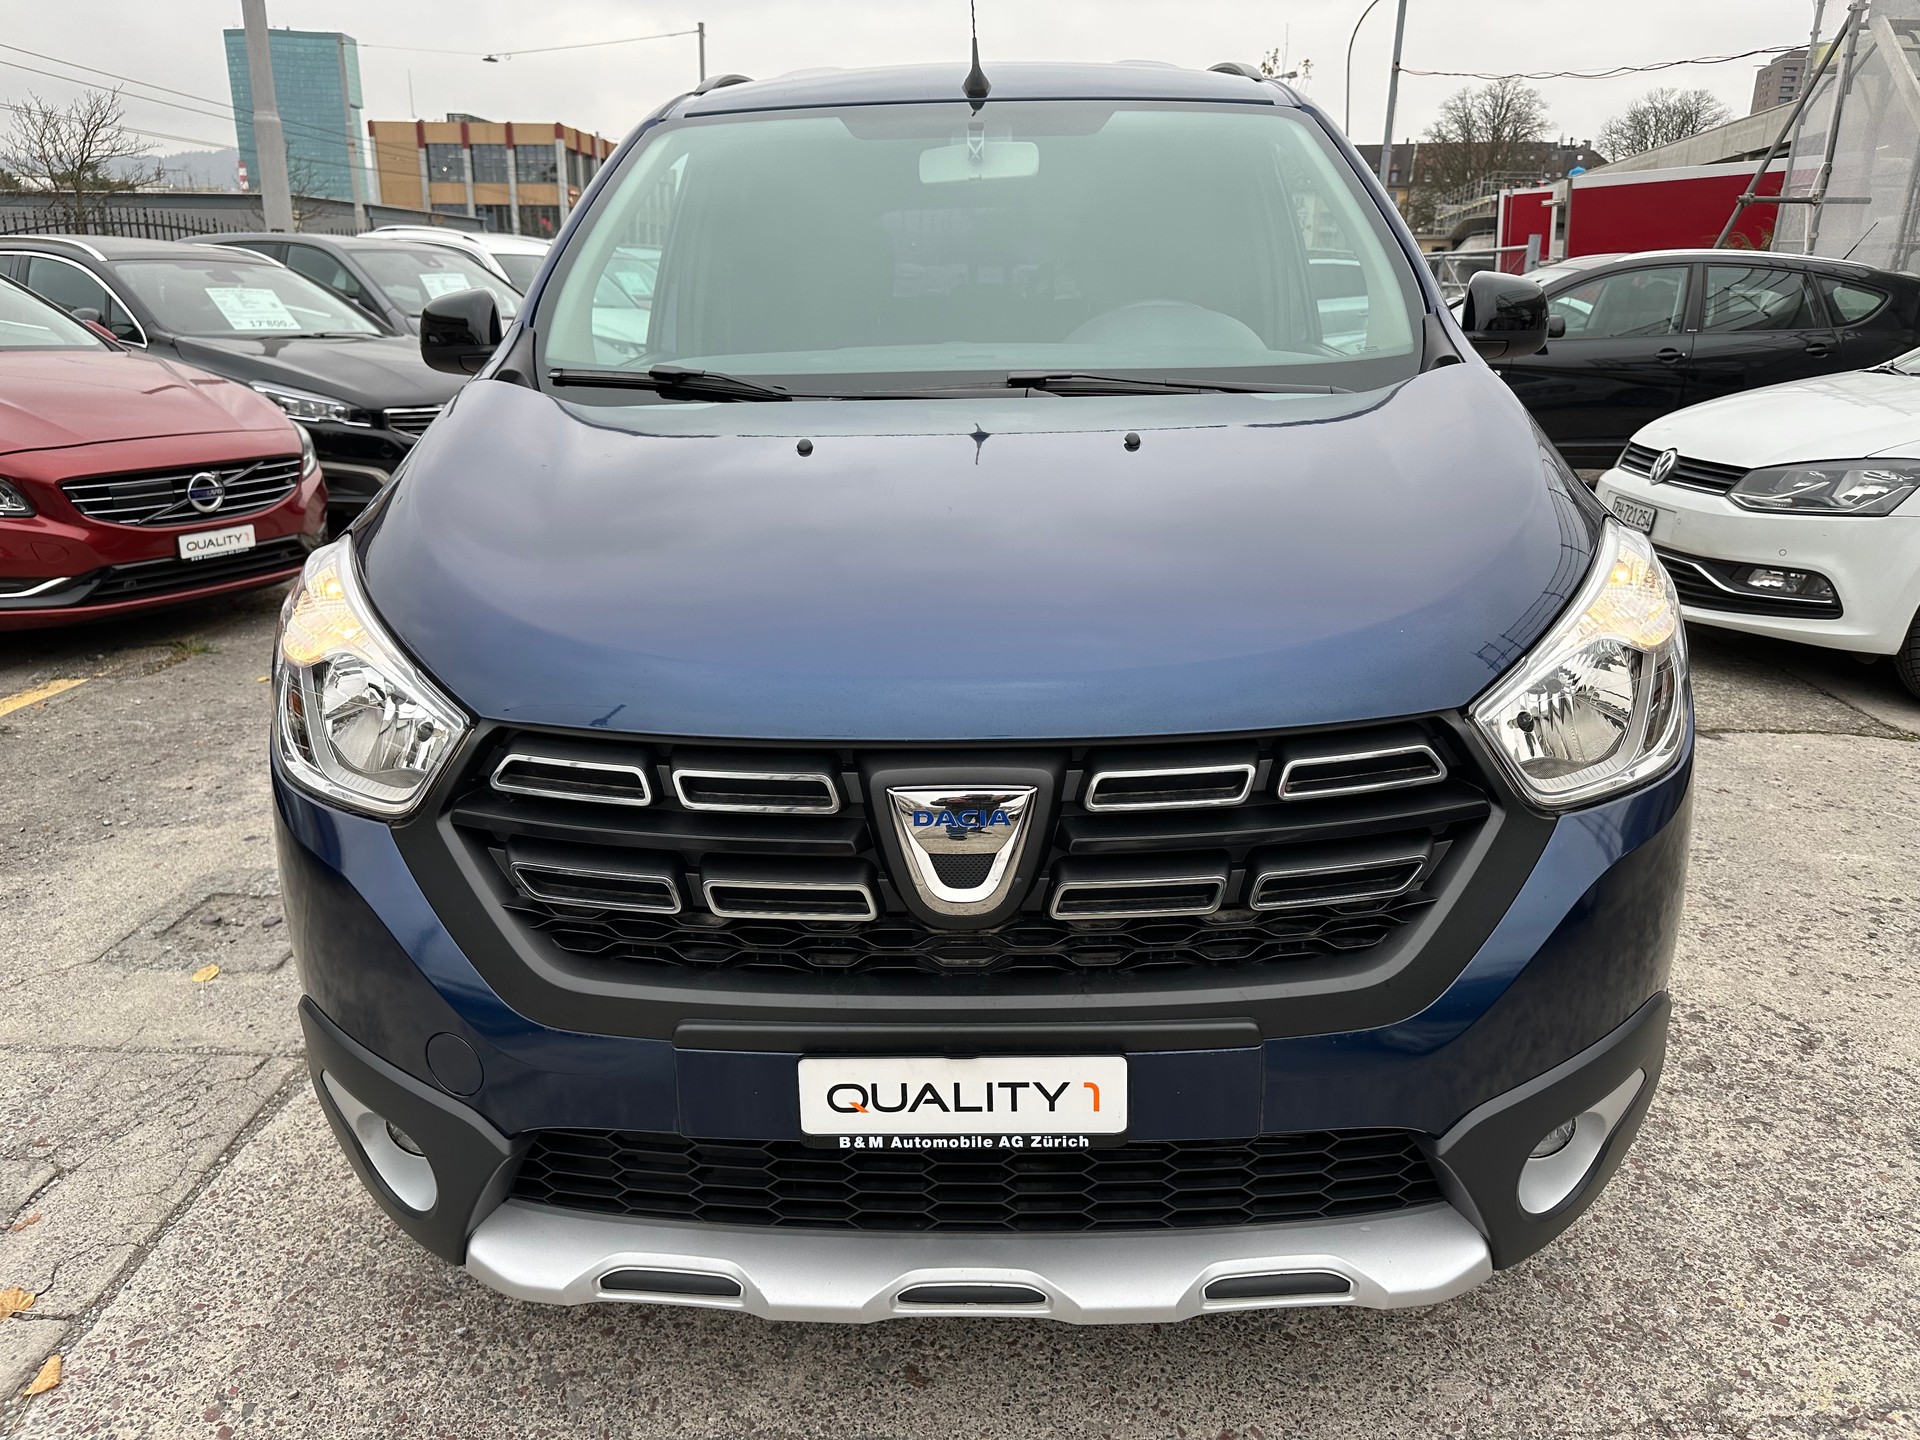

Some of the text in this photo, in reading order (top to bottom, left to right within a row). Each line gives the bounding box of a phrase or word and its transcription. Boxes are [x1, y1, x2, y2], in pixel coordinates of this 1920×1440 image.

[186, 533, 242, 551] QUALITY
[913, 810, 1012, 828] DACIA
[827, 1082, 1100, 1113] QUALITY 1
[890, 1135, 994, 1149] Automobile
[998, 1135, 1024, 1148] AG
[1030, 1135, 1090, 1148] Zürich
